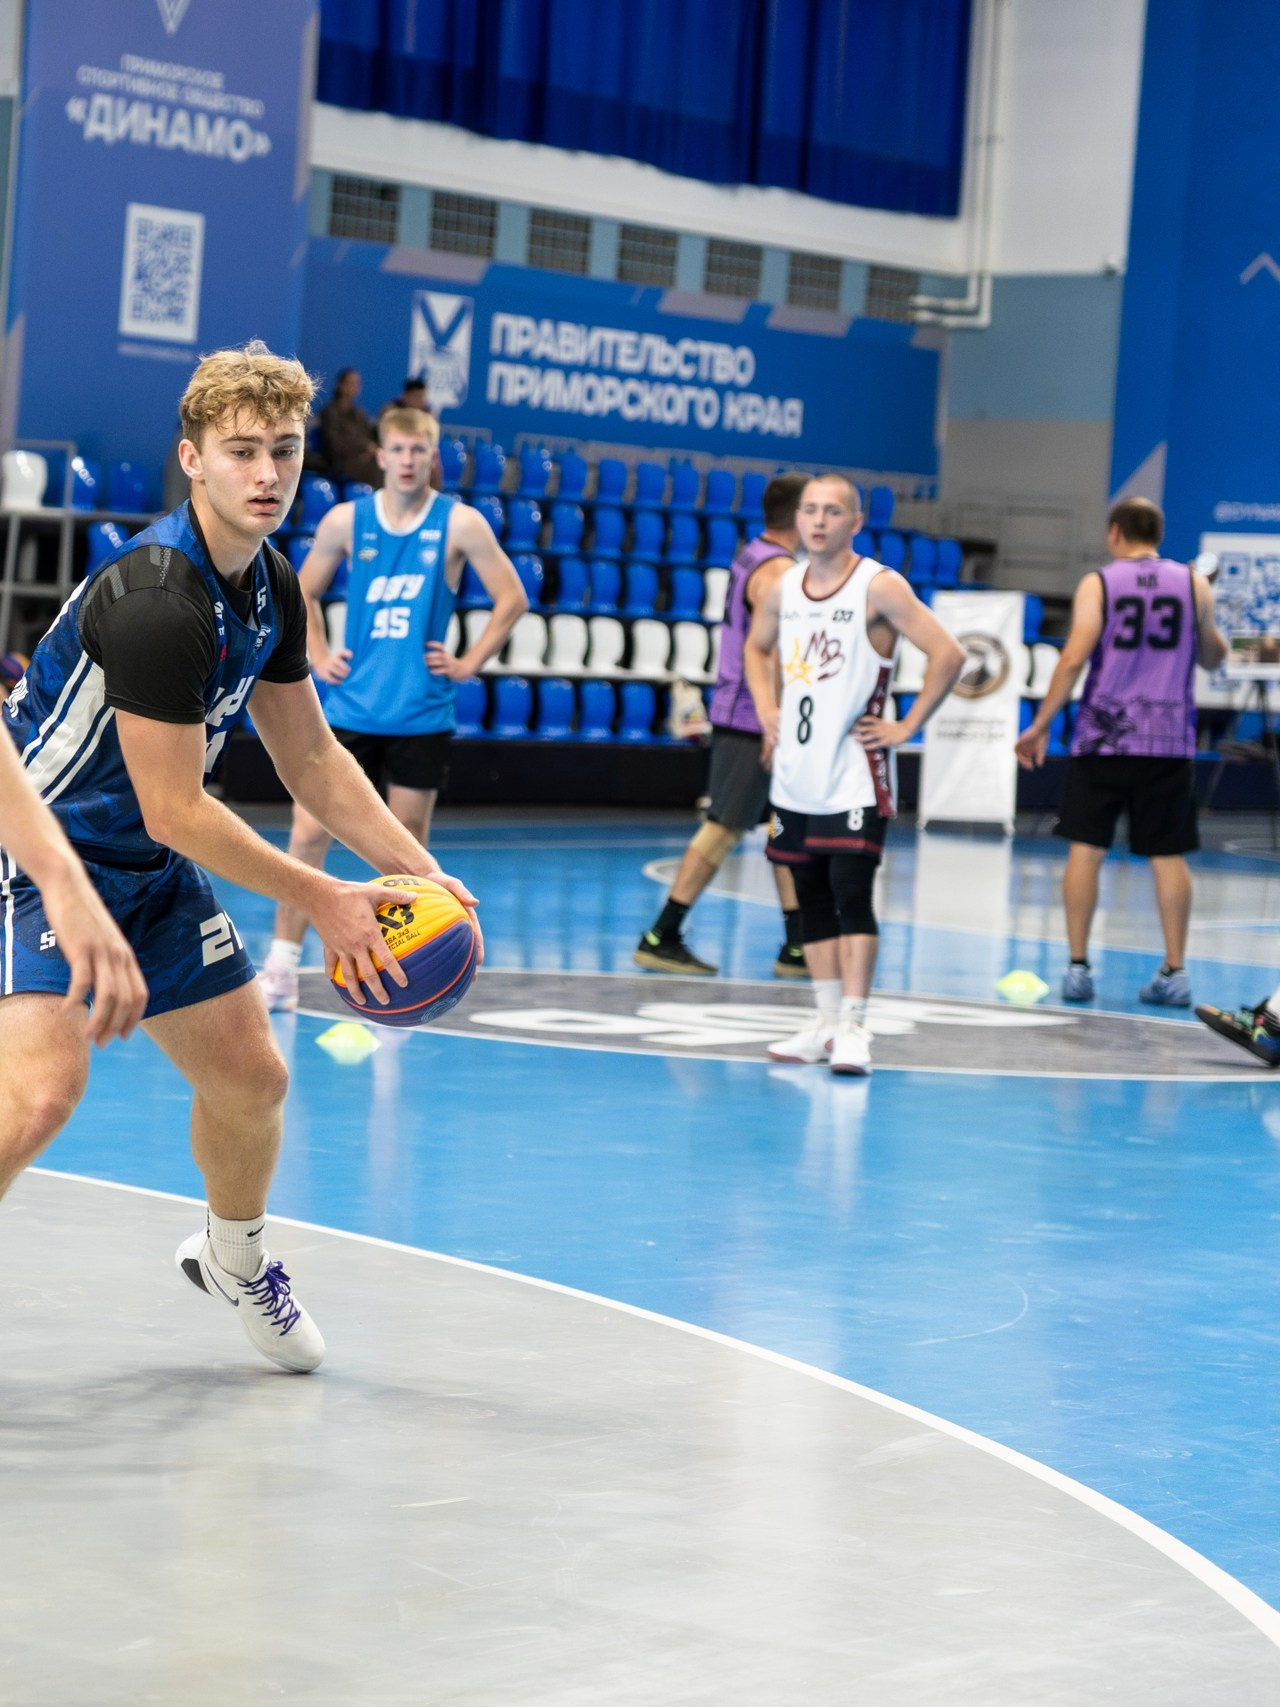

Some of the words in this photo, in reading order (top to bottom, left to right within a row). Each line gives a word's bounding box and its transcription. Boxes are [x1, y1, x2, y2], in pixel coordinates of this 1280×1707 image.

[64, 92, 273, 164] «ДИНАМО»
[489, 311, 756, 388] ПРАВИТЕЛЬСТВО
[486, 360, 720, 431] ПРИМОРСКОГО
[722, 389, 804, 439] КРАЯ
[1113, 594, 1183, 651] 33
[797, 696, 813, 745] 8
[846, 807, 865, 832] 8
